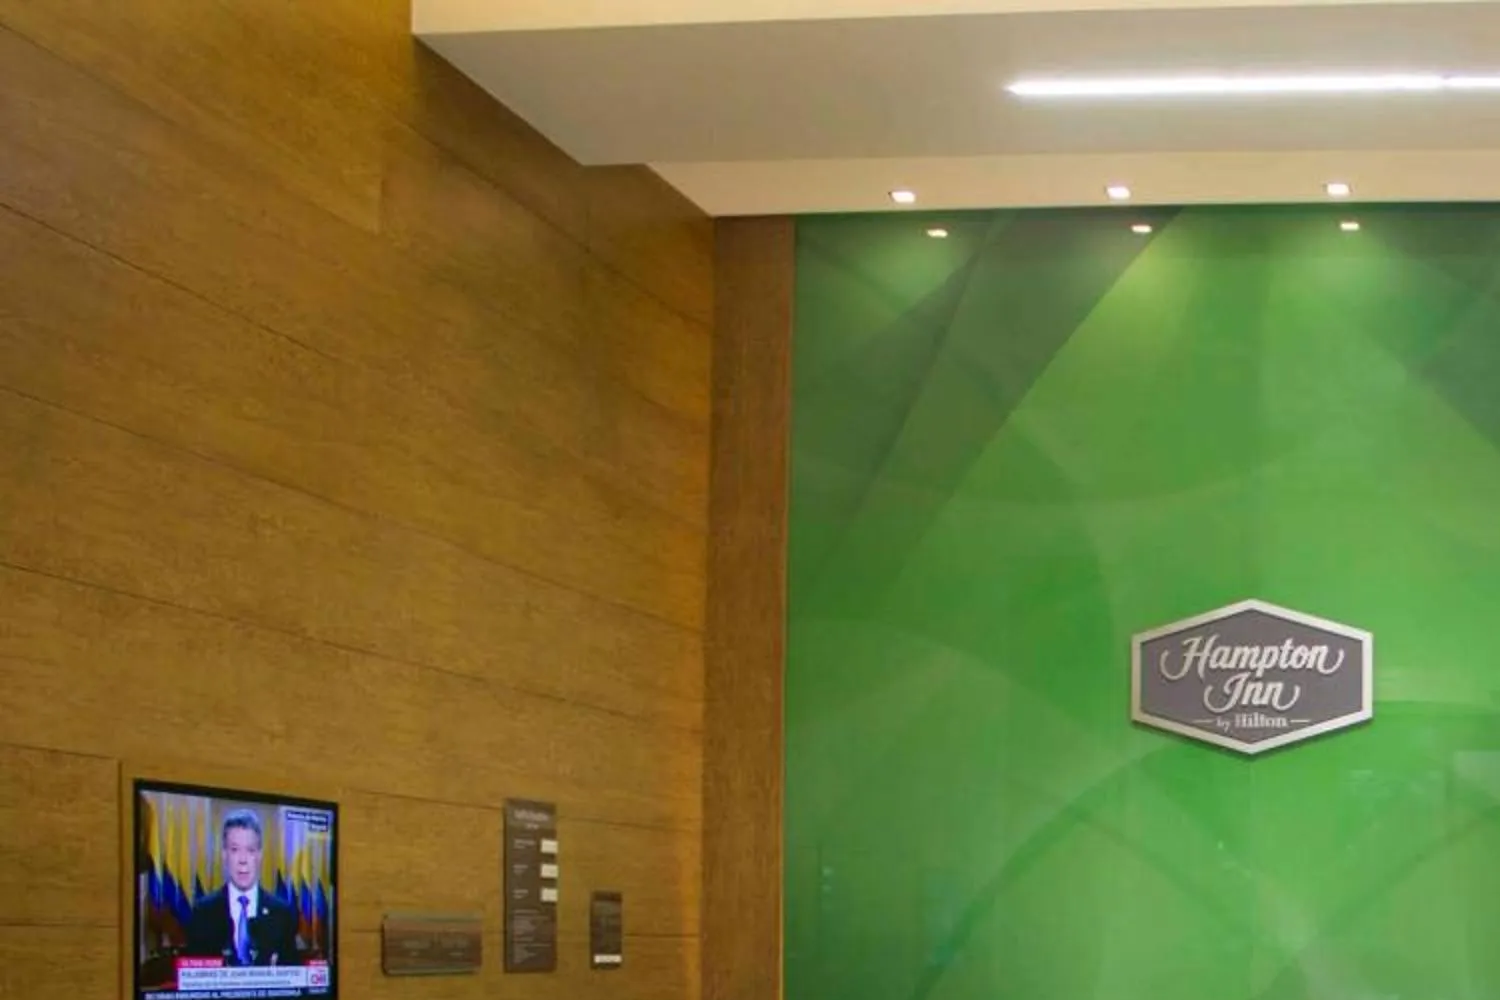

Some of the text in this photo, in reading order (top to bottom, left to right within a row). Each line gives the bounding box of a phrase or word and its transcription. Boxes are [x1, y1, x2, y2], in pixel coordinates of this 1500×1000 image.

[1160, 634, 1345, 680] Hampton
[1203, 672, 1300, 713] Inn
[1215, 711, 1288, 731] by Hilton
